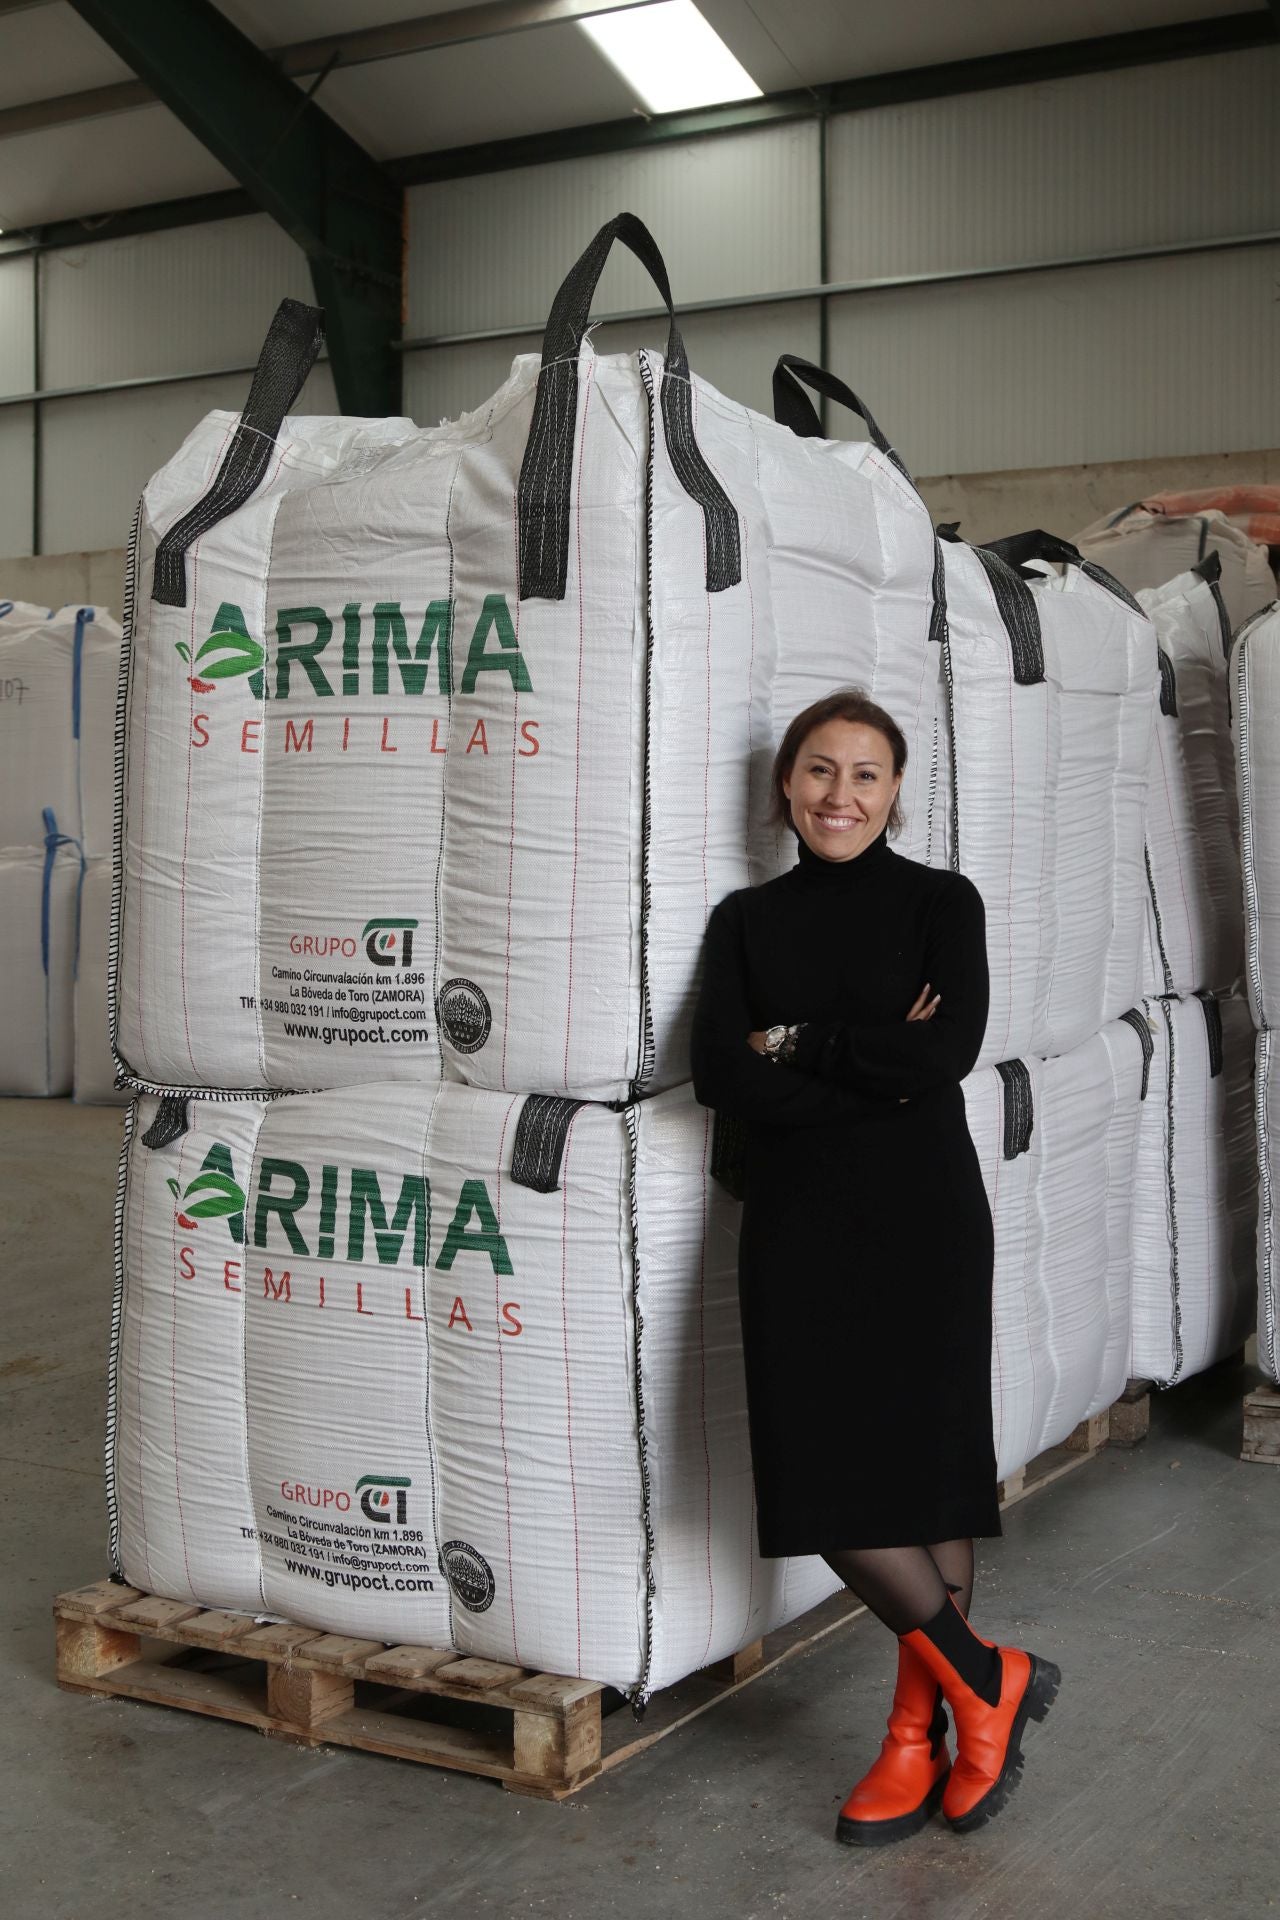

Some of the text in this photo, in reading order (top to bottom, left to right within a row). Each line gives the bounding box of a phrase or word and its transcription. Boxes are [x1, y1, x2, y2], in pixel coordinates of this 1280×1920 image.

[196, 594, 534, 700] ARIMA
[191, 714, 540, 757] SEMILLAS
[289, 935, 357, 958] GRUPO
[271, 966, 425, 985] Camino Circunvalación km 1.896
[239, 996, 257, 1009] Tlf:
[260, 999, 273, 1010] +34
[275, 1001, 289, 1014] 980
[290, 1003, 307, 1017] 032
[309, 1006, 325, 1018] 191
[331, 1007, 427, 1022] info@grupoct.com
[290, 985, 425, 1004] La Bóveda de Toro (ZAMORA)
[284, 1022, 429, 1046] www.grupoct.com
[183, 1142, 515, 1276] ARIMA
[179, 1247, 523, 1337] SEMILLAS
[280, 1481, 351, 1512] GRUPO
[266, 1505, 424, 1542] Camino Circunvalación km 1.896
[259, 1532, 273, 1546] +34
[274, 1536, 289, 1551] 980
[290, 1541, 307, 1556] 032
[308, 1547, 325, 1561] 191
[332, 1554, 430, 1573] info@grupoct.com
[287, 1527, 427, 1559] La Bóveda de Toro (ZAMORA)
[284, 1558, 434, 1592] www.grupoct.com
